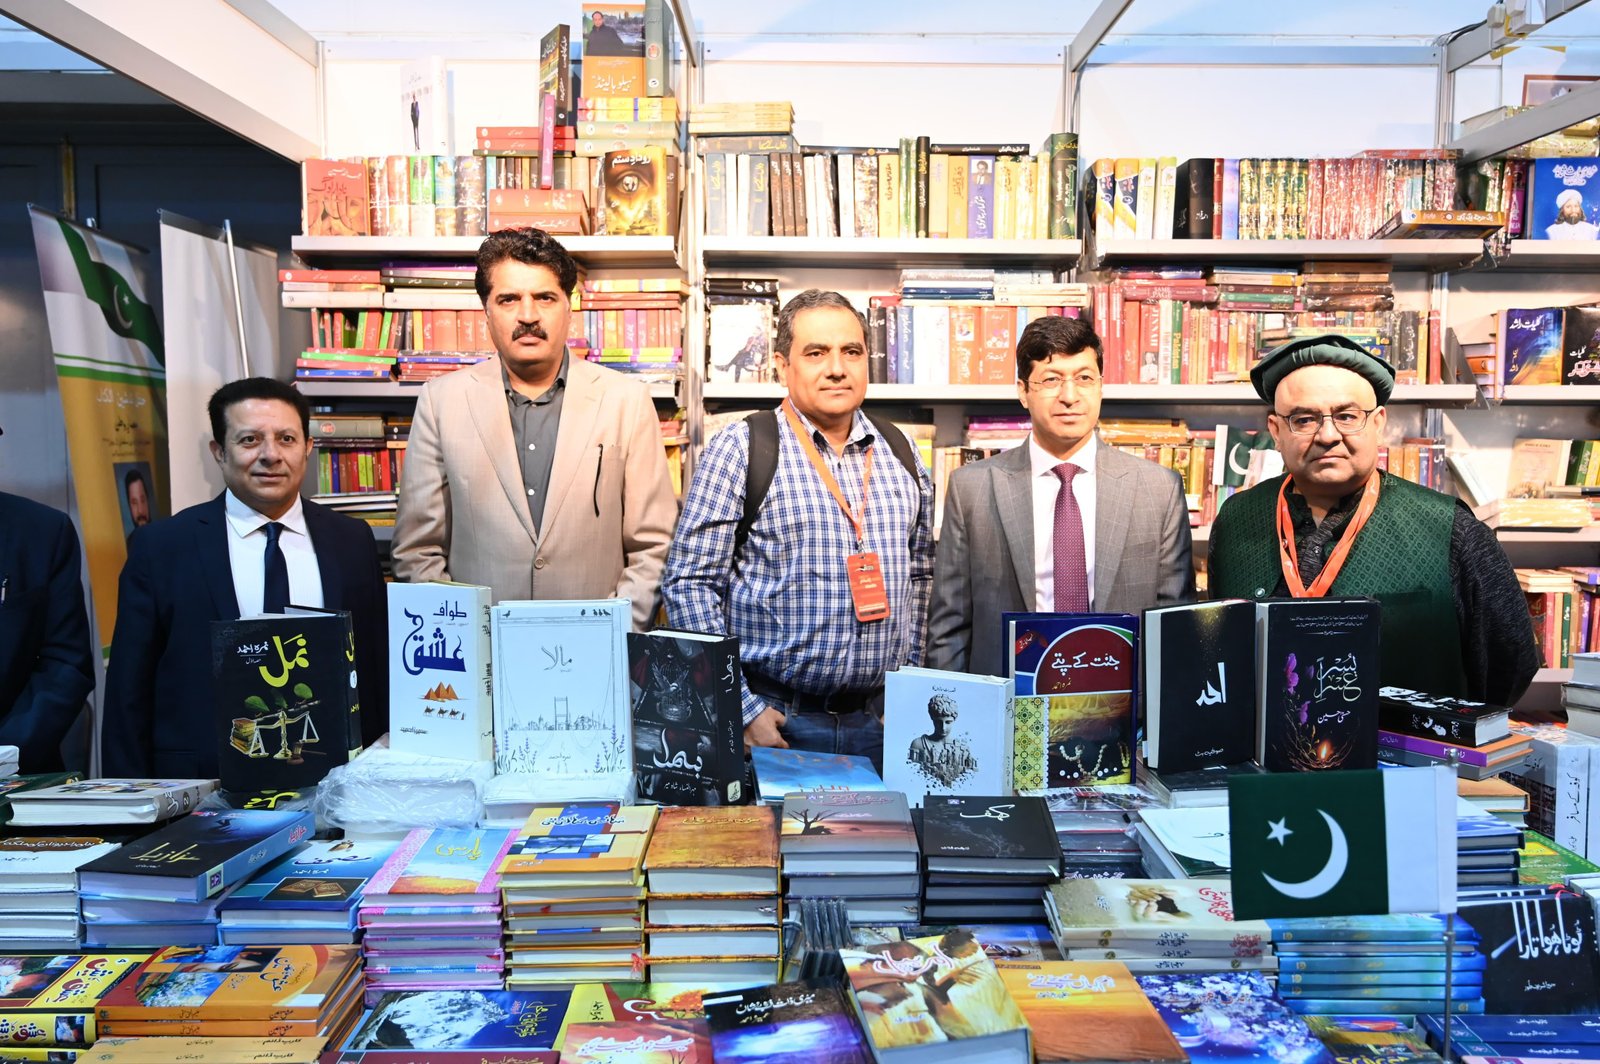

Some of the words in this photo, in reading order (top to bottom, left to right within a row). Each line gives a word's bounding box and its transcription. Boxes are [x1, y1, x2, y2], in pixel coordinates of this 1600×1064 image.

[1150, 306, 1159, 347] JINNAH
[1172, 332, 1182, 369] Pakistan
[433, 599, 467, 621] طواف
[402, 607, 467, 676] عشق
[1051, 652, 1073, 676] پتے
[1072, 651, 1090, 668] کے
[1090, 655, 1120, 671] جنت
[434, 836, 482, 861] پارس
